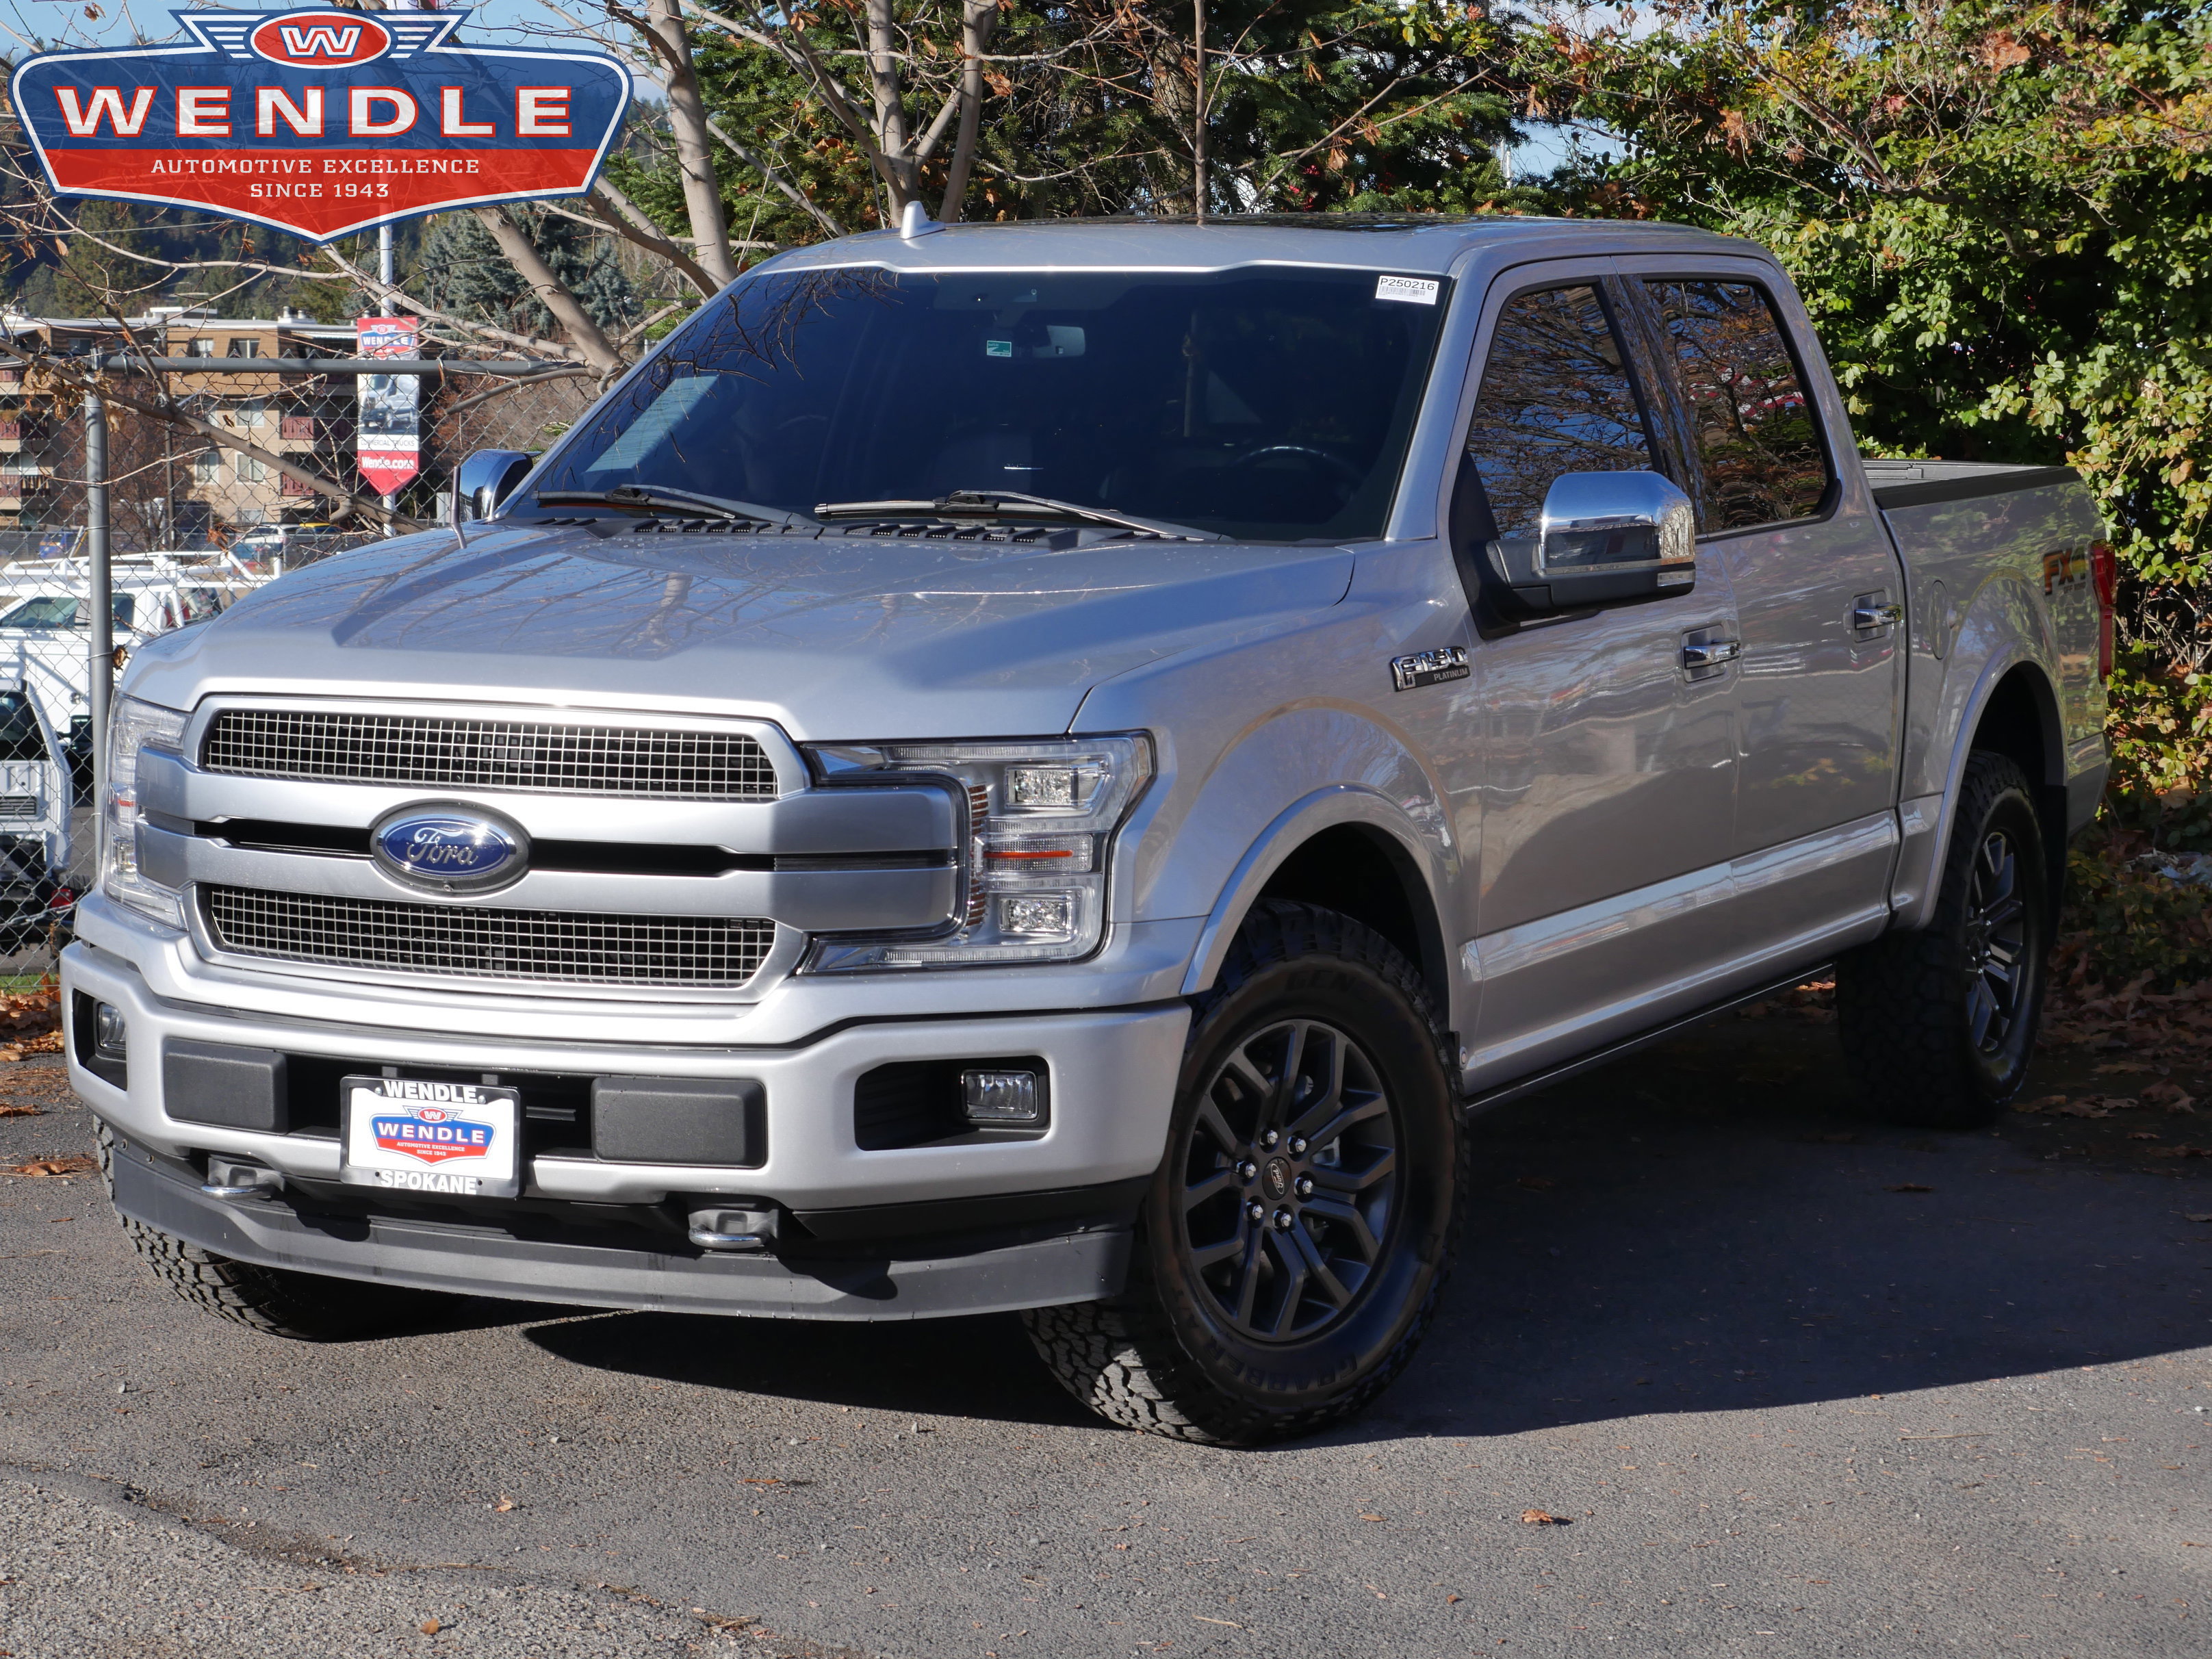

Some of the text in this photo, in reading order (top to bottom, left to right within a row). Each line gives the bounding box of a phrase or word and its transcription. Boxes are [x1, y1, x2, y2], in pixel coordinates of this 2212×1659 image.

[1380, 278, 1435, 291] P250216
[1434, 667, 1468, 681] PLATINUM
[407, 827, 480, 866] Ford
[383, 1080, 478, 1103] WENDLE
[378, 1122, 485, 1144] WENDLE
[381, 1170, 477, 1195] SPOKANE
